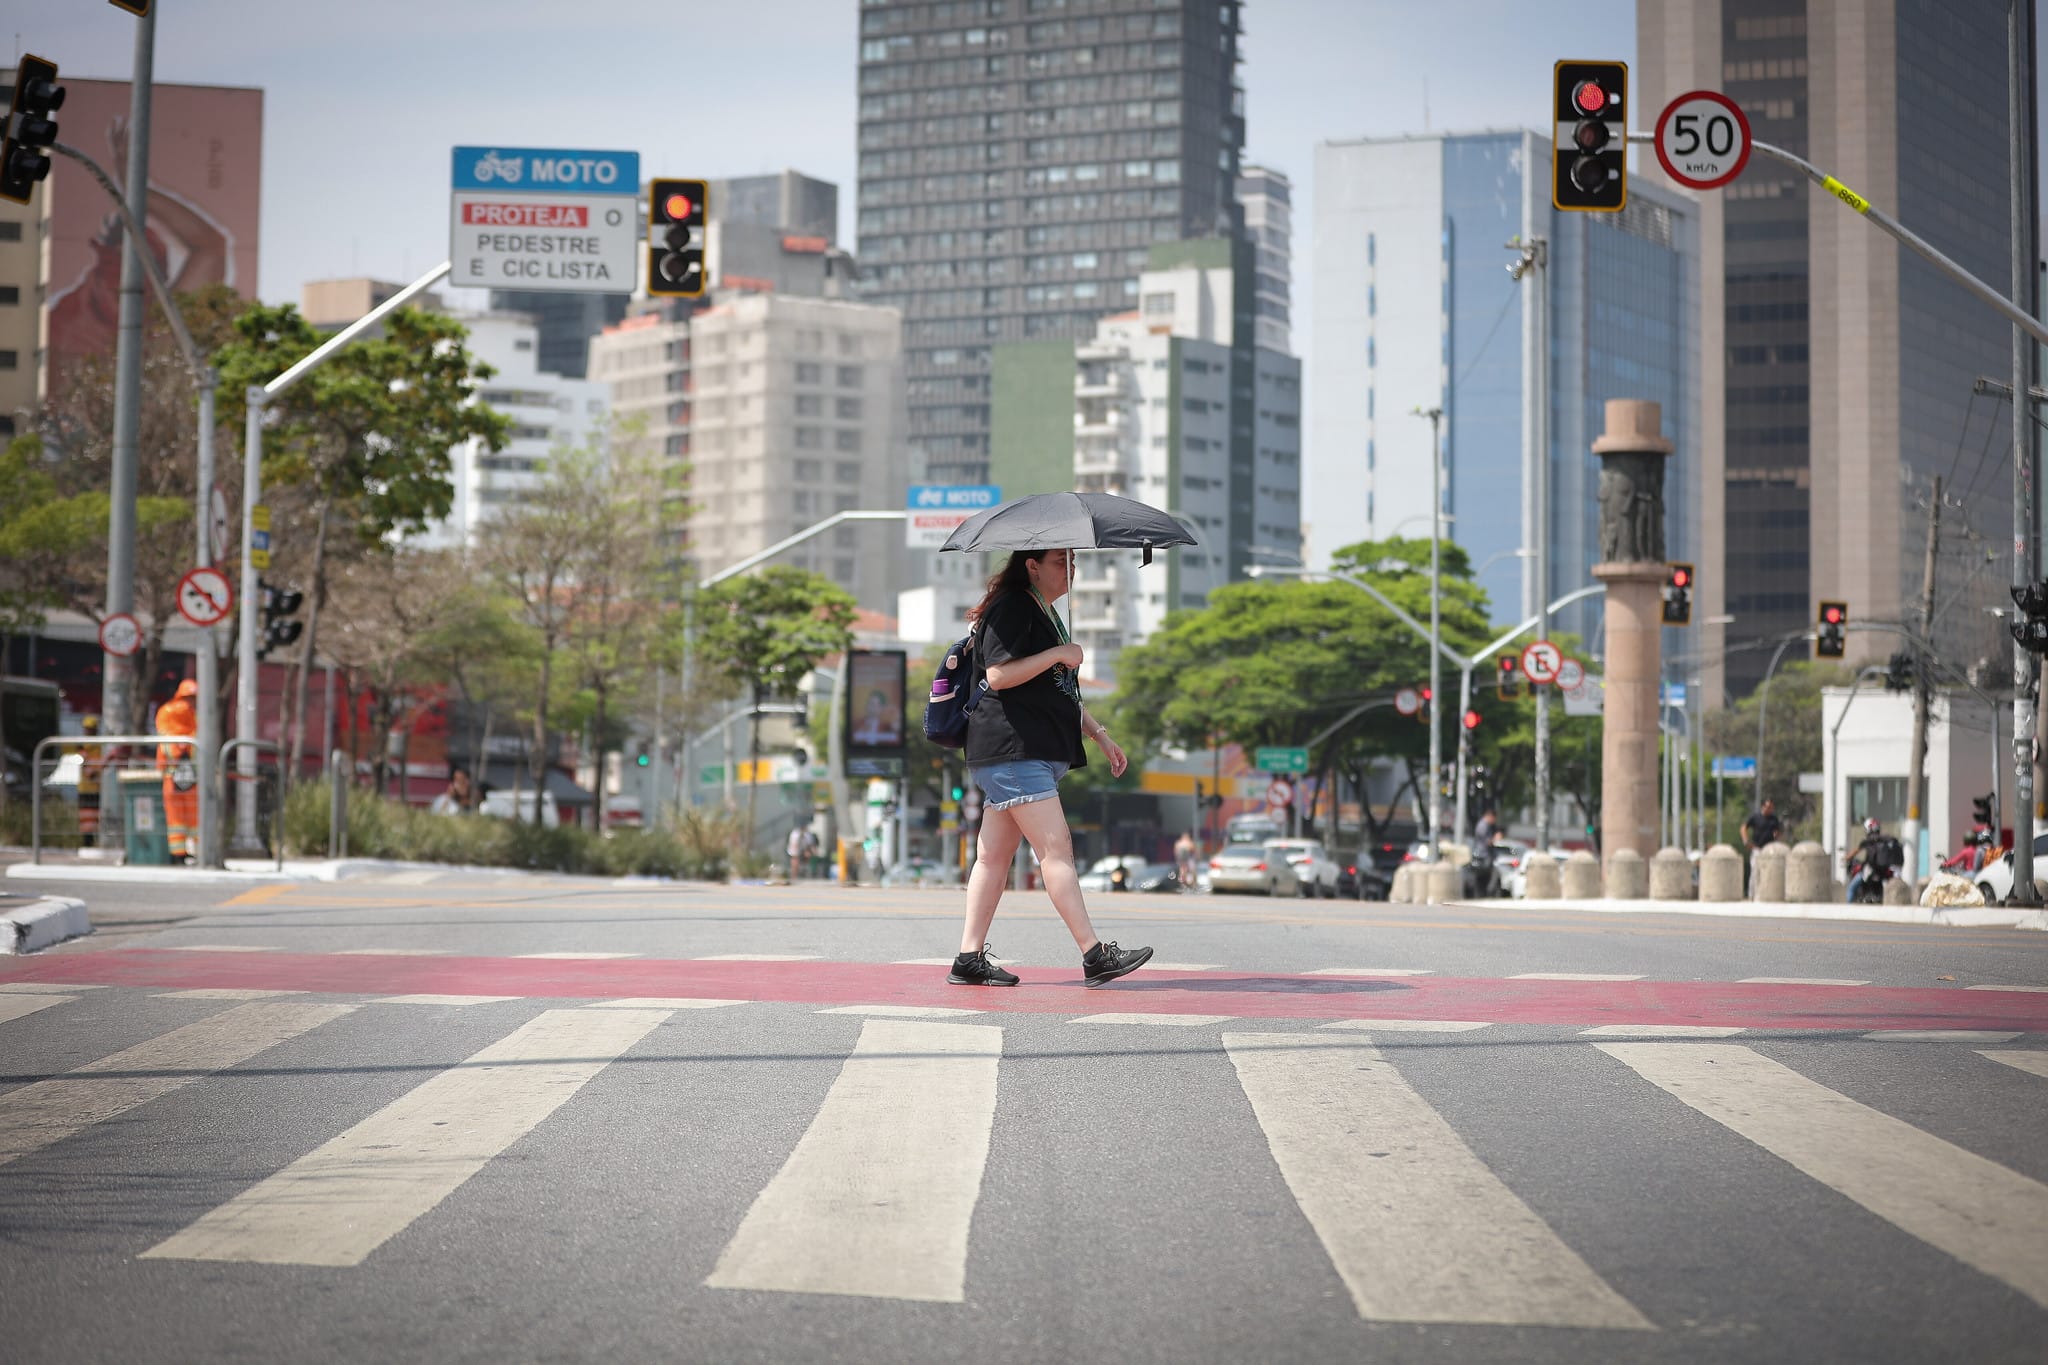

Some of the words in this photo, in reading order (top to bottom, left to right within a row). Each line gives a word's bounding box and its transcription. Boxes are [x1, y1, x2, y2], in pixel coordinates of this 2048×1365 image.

[1674, 115, 1733, 156] 50
[531, 159, 618, 184] MOTO
[1686, 163, 1718, 173] km/h
[471, 205, 580, 225] PROTEJA
[605, 209, 623, 226] O
[477, 234, 601, 255] PEDESTRE
[470, 259, 484, 276] E
[946, 490, 992, 505] MOTO
